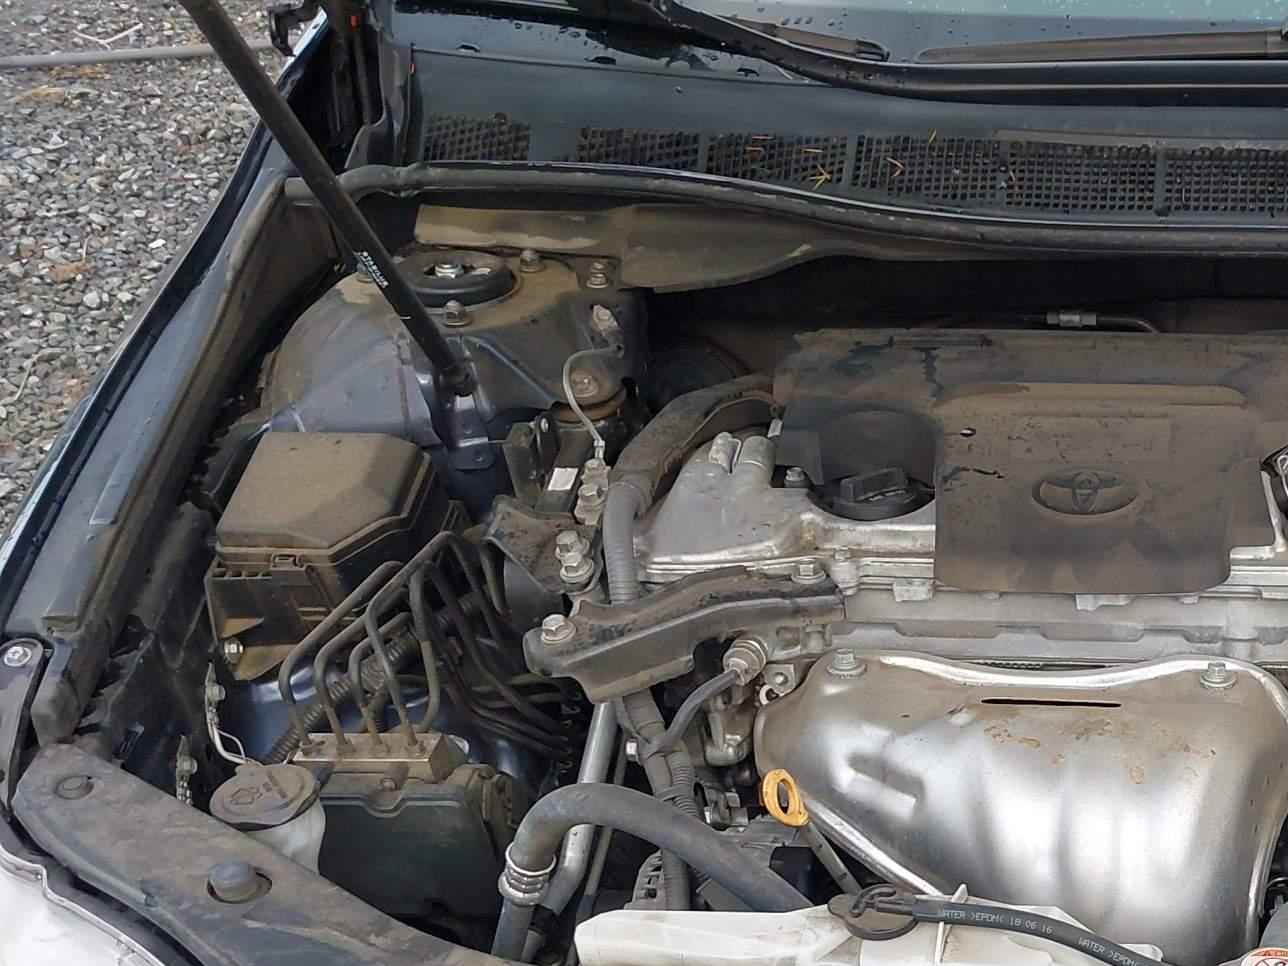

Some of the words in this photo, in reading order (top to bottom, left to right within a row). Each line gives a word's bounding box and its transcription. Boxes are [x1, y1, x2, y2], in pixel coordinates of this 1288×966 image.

[1010, 917, 1021, 927] 18
[1025, 920, 1037, 930] 06
[1041, 924, 1053, 934] 16
[1078, 937, 1106, 954] WATER
